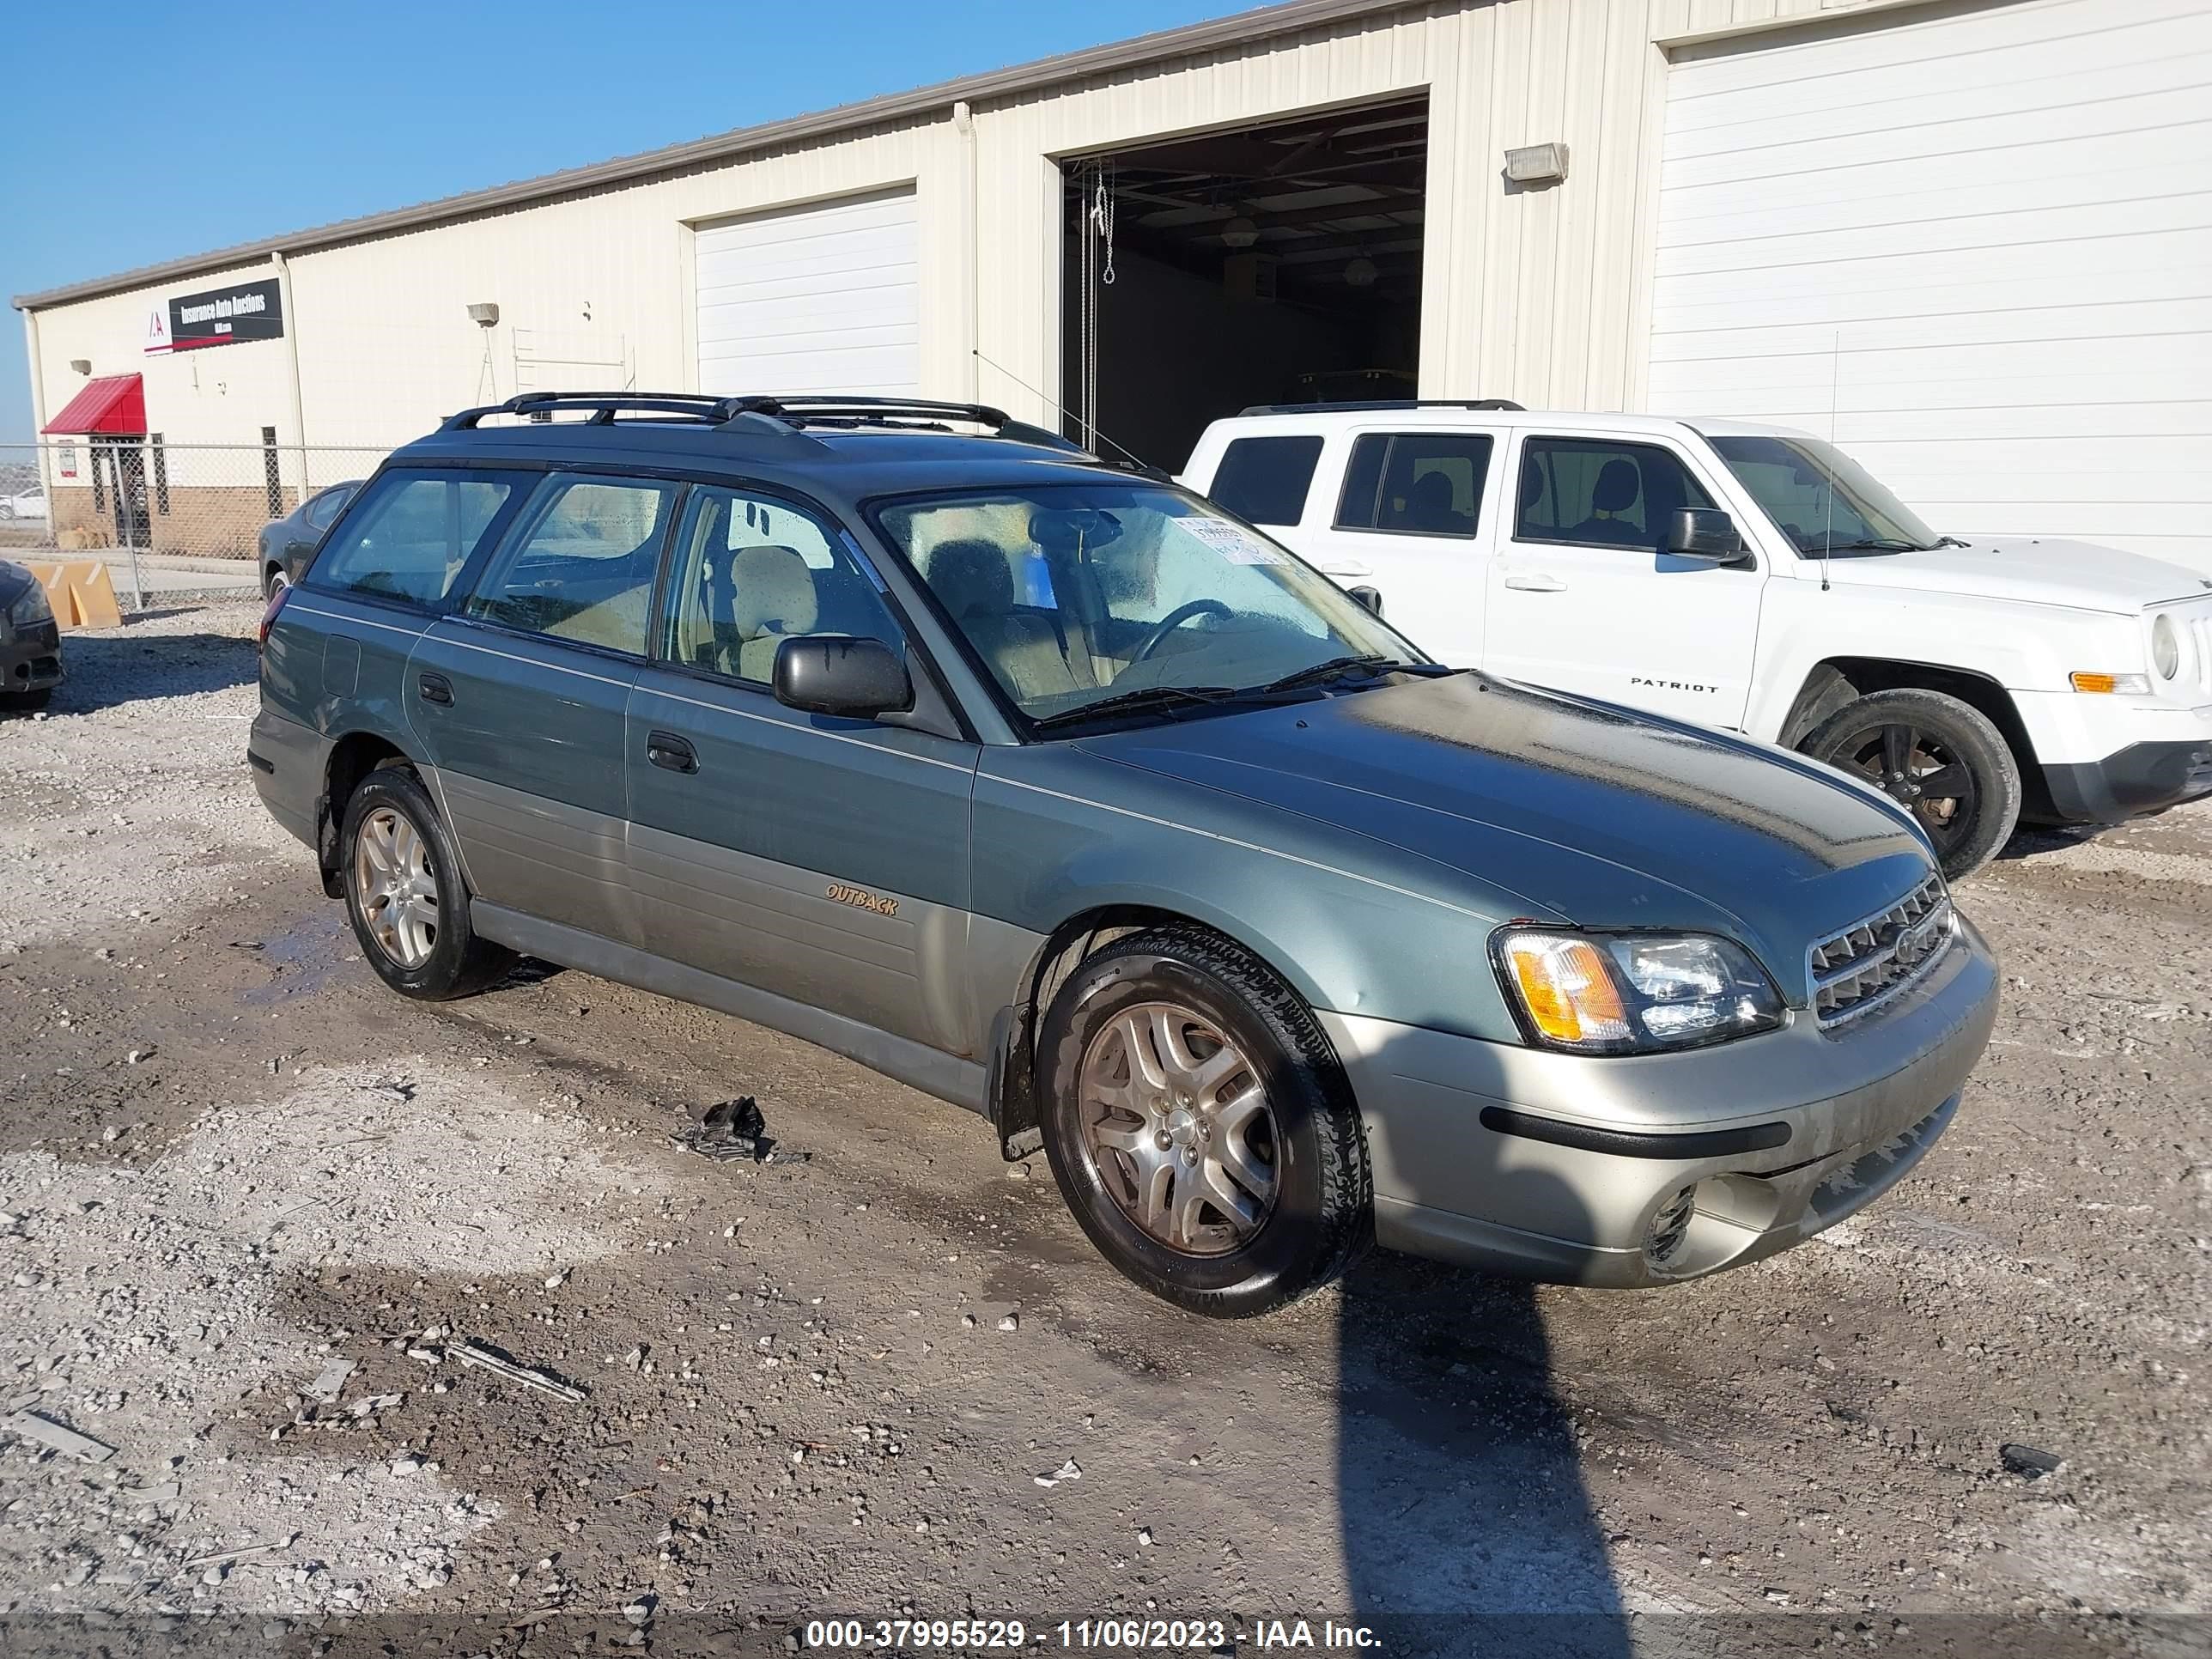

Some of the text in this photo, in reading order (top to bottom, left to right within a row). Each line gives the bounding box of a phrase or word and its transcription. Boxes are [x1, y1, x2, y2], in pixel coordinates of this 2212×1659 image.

[181, 303, 216, 325] Insurance
[216, 299, 233, 319] Auto
[232, 294, 265, 315] Auctions
[1631, 678, 1719, 693] PATRIOT
[827, 883, 899, 916] OUTBACK
